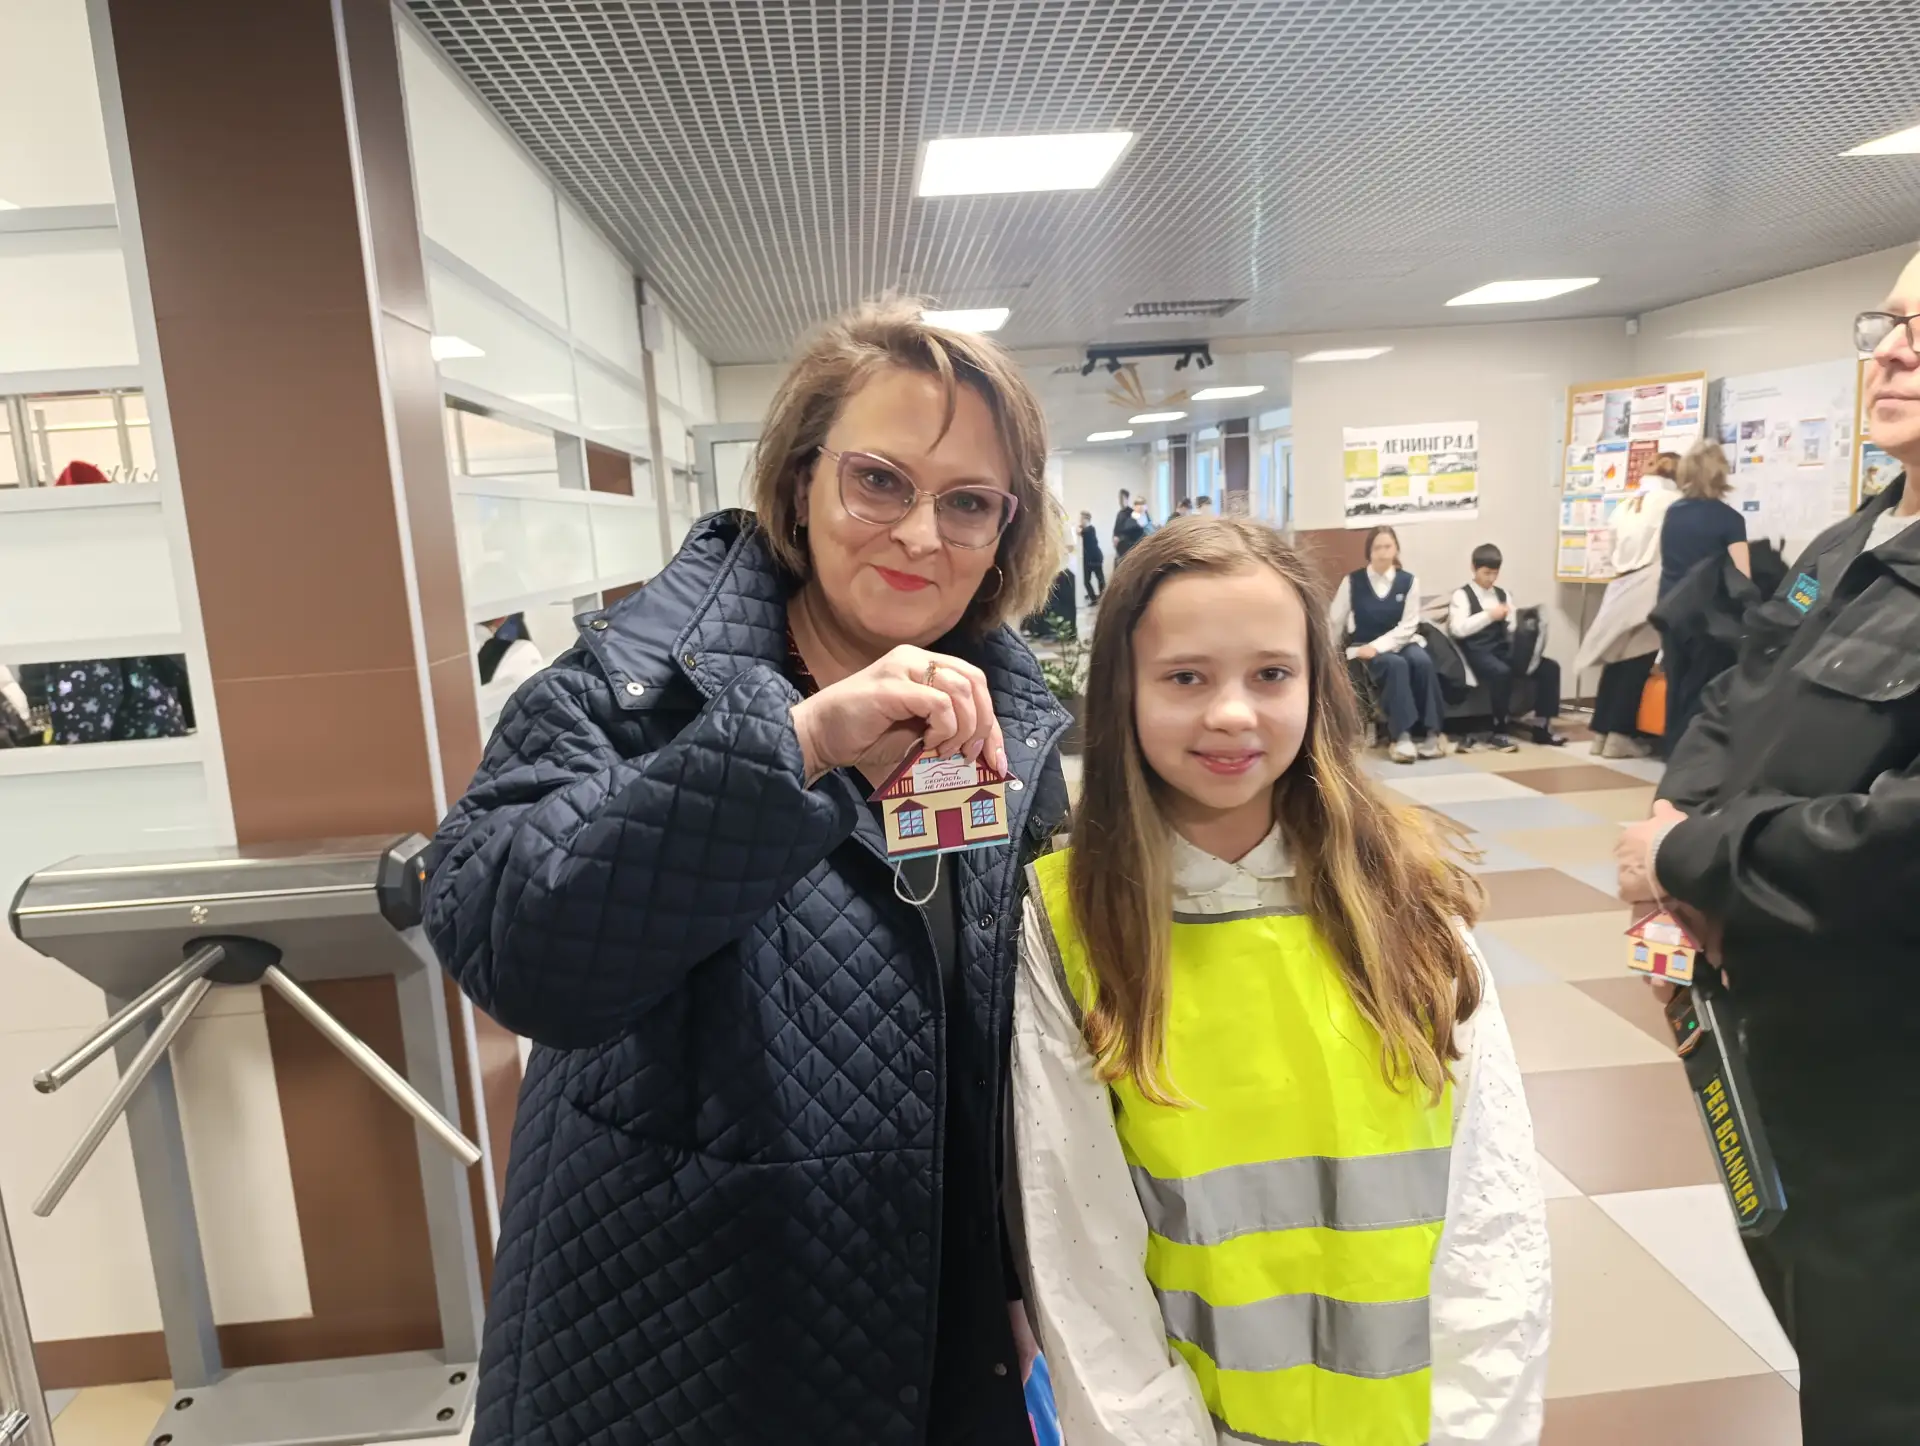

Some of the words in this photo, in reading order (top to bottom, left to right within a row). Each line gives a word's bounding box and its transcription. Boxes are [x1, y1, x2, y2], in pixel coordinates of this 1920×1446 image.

[1382, 433, 1474, 454] ЛЕНИНГРАД
[924, 775, 961, 785] СКОРОСТЬ
[935, 779, 971, 789] ГЛАВНОЕ!
[1715, 1118, 1759, 1216] SCANNER
